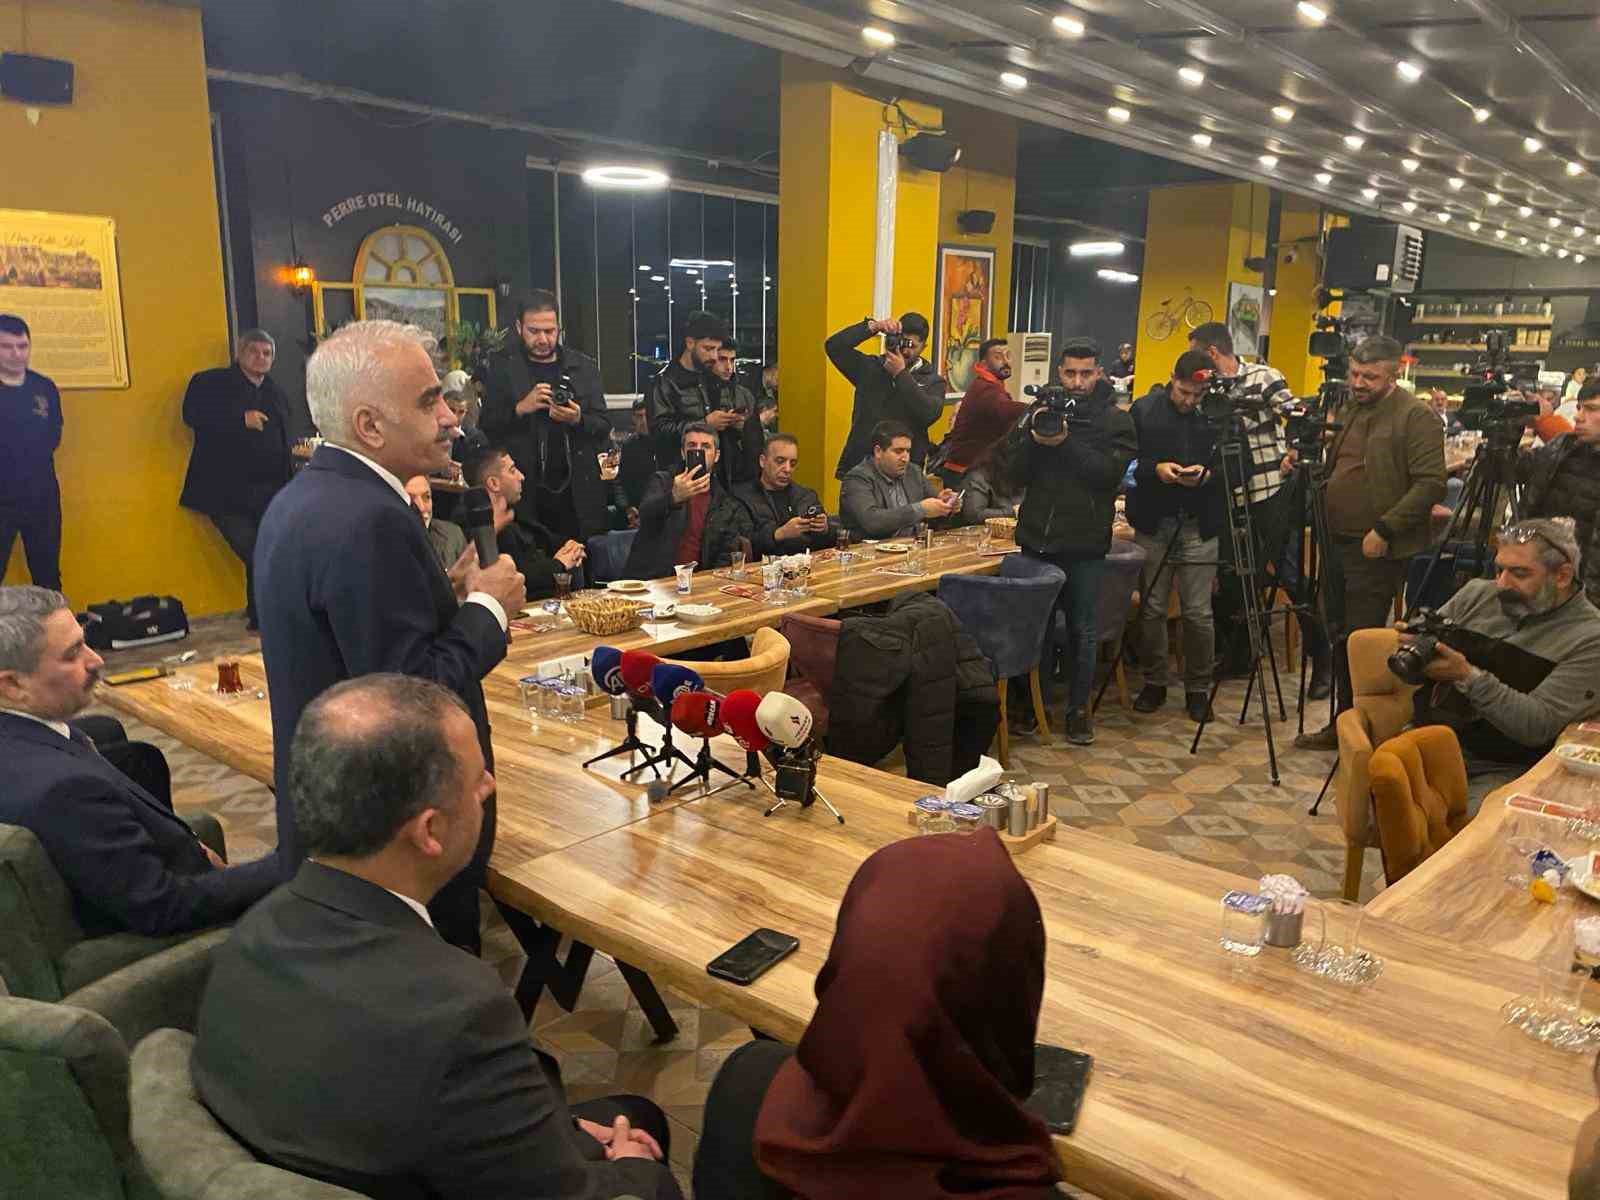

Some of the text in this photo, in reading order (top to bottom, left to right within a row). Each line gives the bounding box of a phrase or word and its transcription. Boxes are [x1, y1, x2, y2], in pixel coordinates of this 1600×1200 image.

[322, 192, 463, 244] PERRE OTEL HATIRASI
